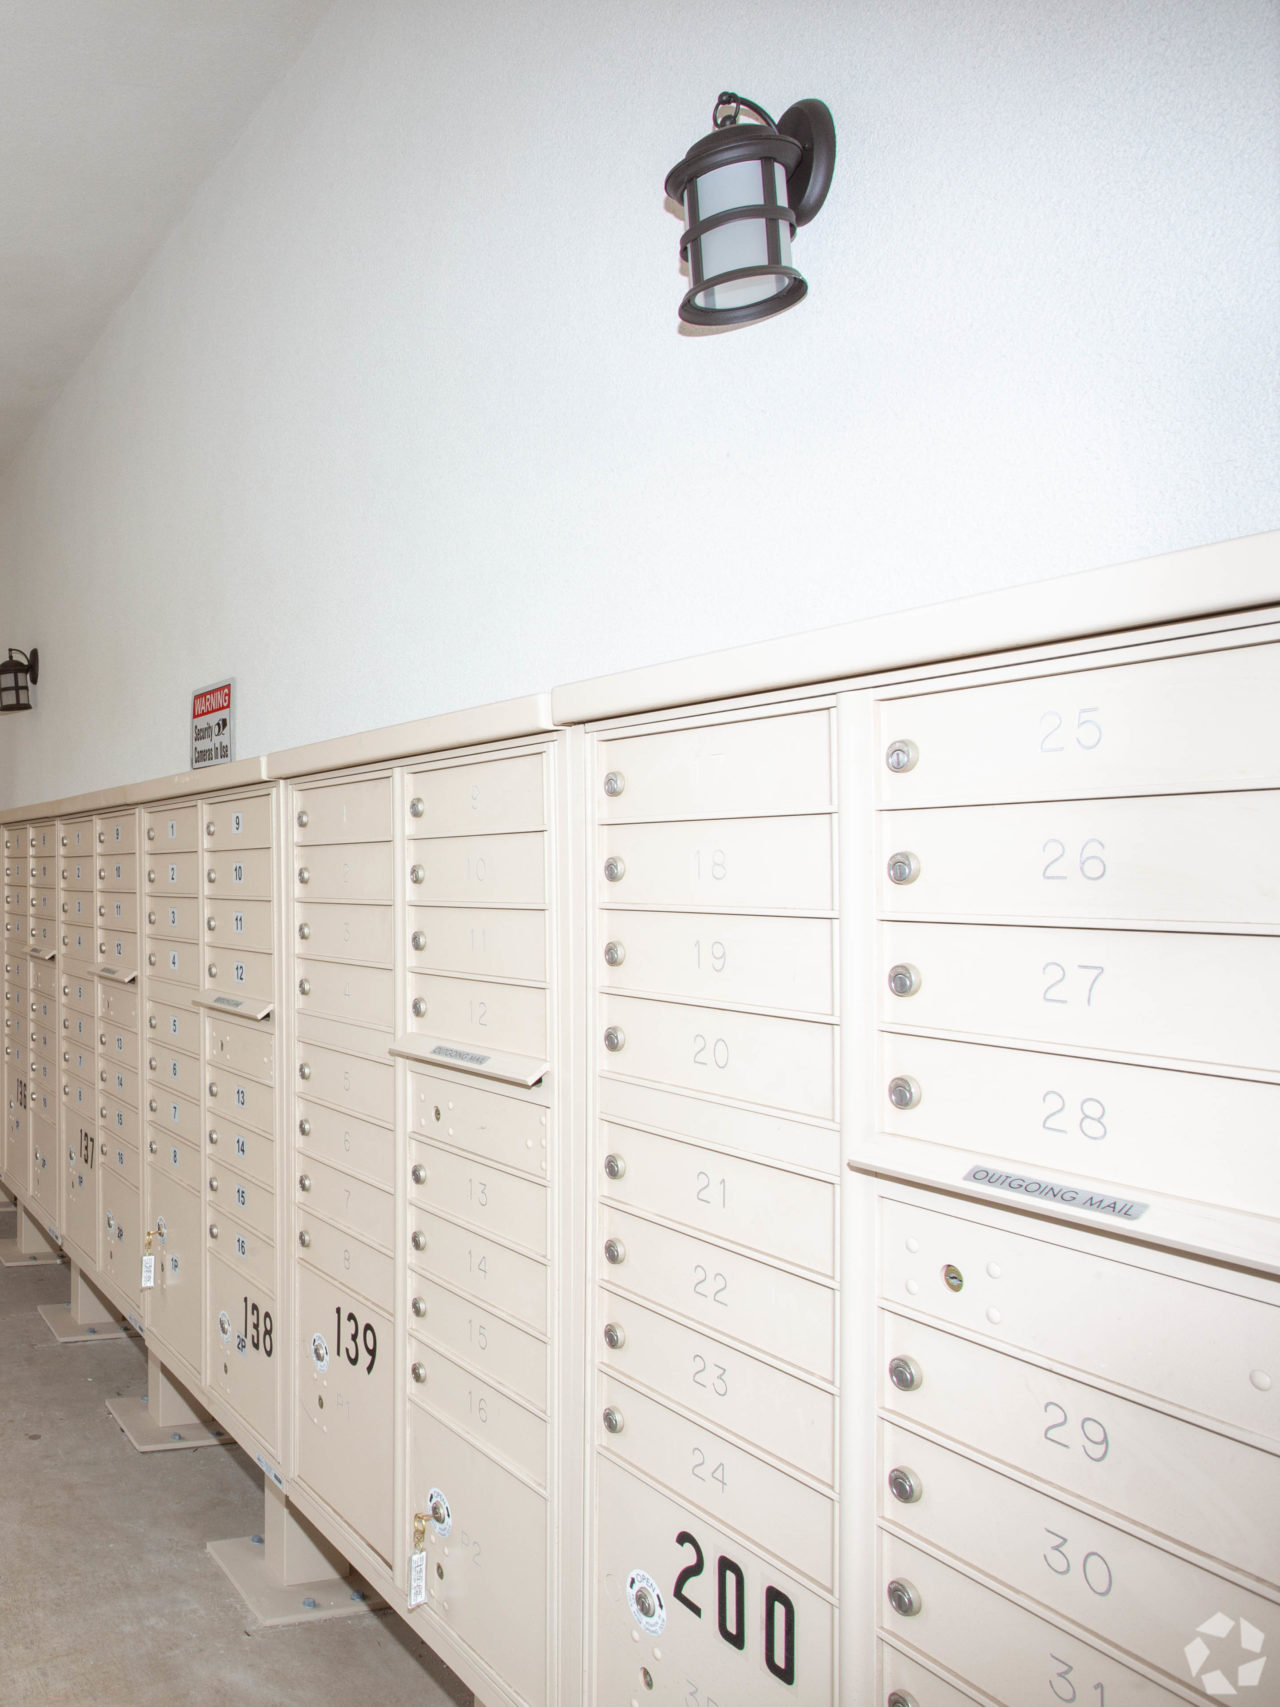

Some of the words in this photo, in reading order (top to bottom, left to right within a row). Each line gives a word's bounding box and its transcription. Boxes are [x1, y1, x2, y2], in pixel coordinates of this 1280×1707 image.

[194, 688, 229, 716] WARNING
[194, 722, 213, 742] Security
[1039, 705, 1104, 753] 25
[194, 746, 213, 764] Cameras
[219, 741, 229, 759] Use
[235, 815, 240, 831] 9
[234, 865, 243, 881] 10
[693, 848, 728, 882] 18
[1041, 837, 1108, 882] 26
[235, 916, 243, 930] 11
[693, 938, 728, 974] 19
[235, 965, 244, 981] 12
[1041, 961, 1106, 1007] 27
[343, 982, 352, 1000] 4
[468, 999, 488, 1027] 12
[692, 1033, 730, 1070] 20
[343, 1071, 351, 1091] 5
[236, 1089, 245, 1106] 13
[1041, 1089, 1108, 1141] 28
[79, 1128, 95, 1169] 137
[236, 1138, 245, 1155] 14
[343, 1131, 351, 1152] 6
[236, 1189, 245, 1206] 15
[343, 1188, 351, 1208] 7
[468, 1177, 488, 1207] 13
[695, 1170, 727, 1209] 21
[972, 1169, 1080, 1202] OUTGOING
[1082, 1195, 1134, 1217] MAIL
[237, 1238, 246, 1255] 16
[343, 1249, 351, 1270] 8
[468, 1248, 488, 1279] 14
[693, 1263, 728, 1308] 22
[243, 1296, 273, 1358] 138
[335, 1306, 377, 1375] 139
[468, 1318, 488, 1350] 15
[236, 1334, 247, 1352] 2P
[692, 1353, 728, 1397] 23
[467, 1388, 488, 1424] 16
[1043, 1400, 1111, 1463] 29
[691, 1446, 728, 1494] 24
[1042, 1526, 1113, 1598] 30
[635, 1572, 657, 1593] OPEN
[672, 1530, 796, 1687] 200
[1048, 1652, 1106, 1707] 31
